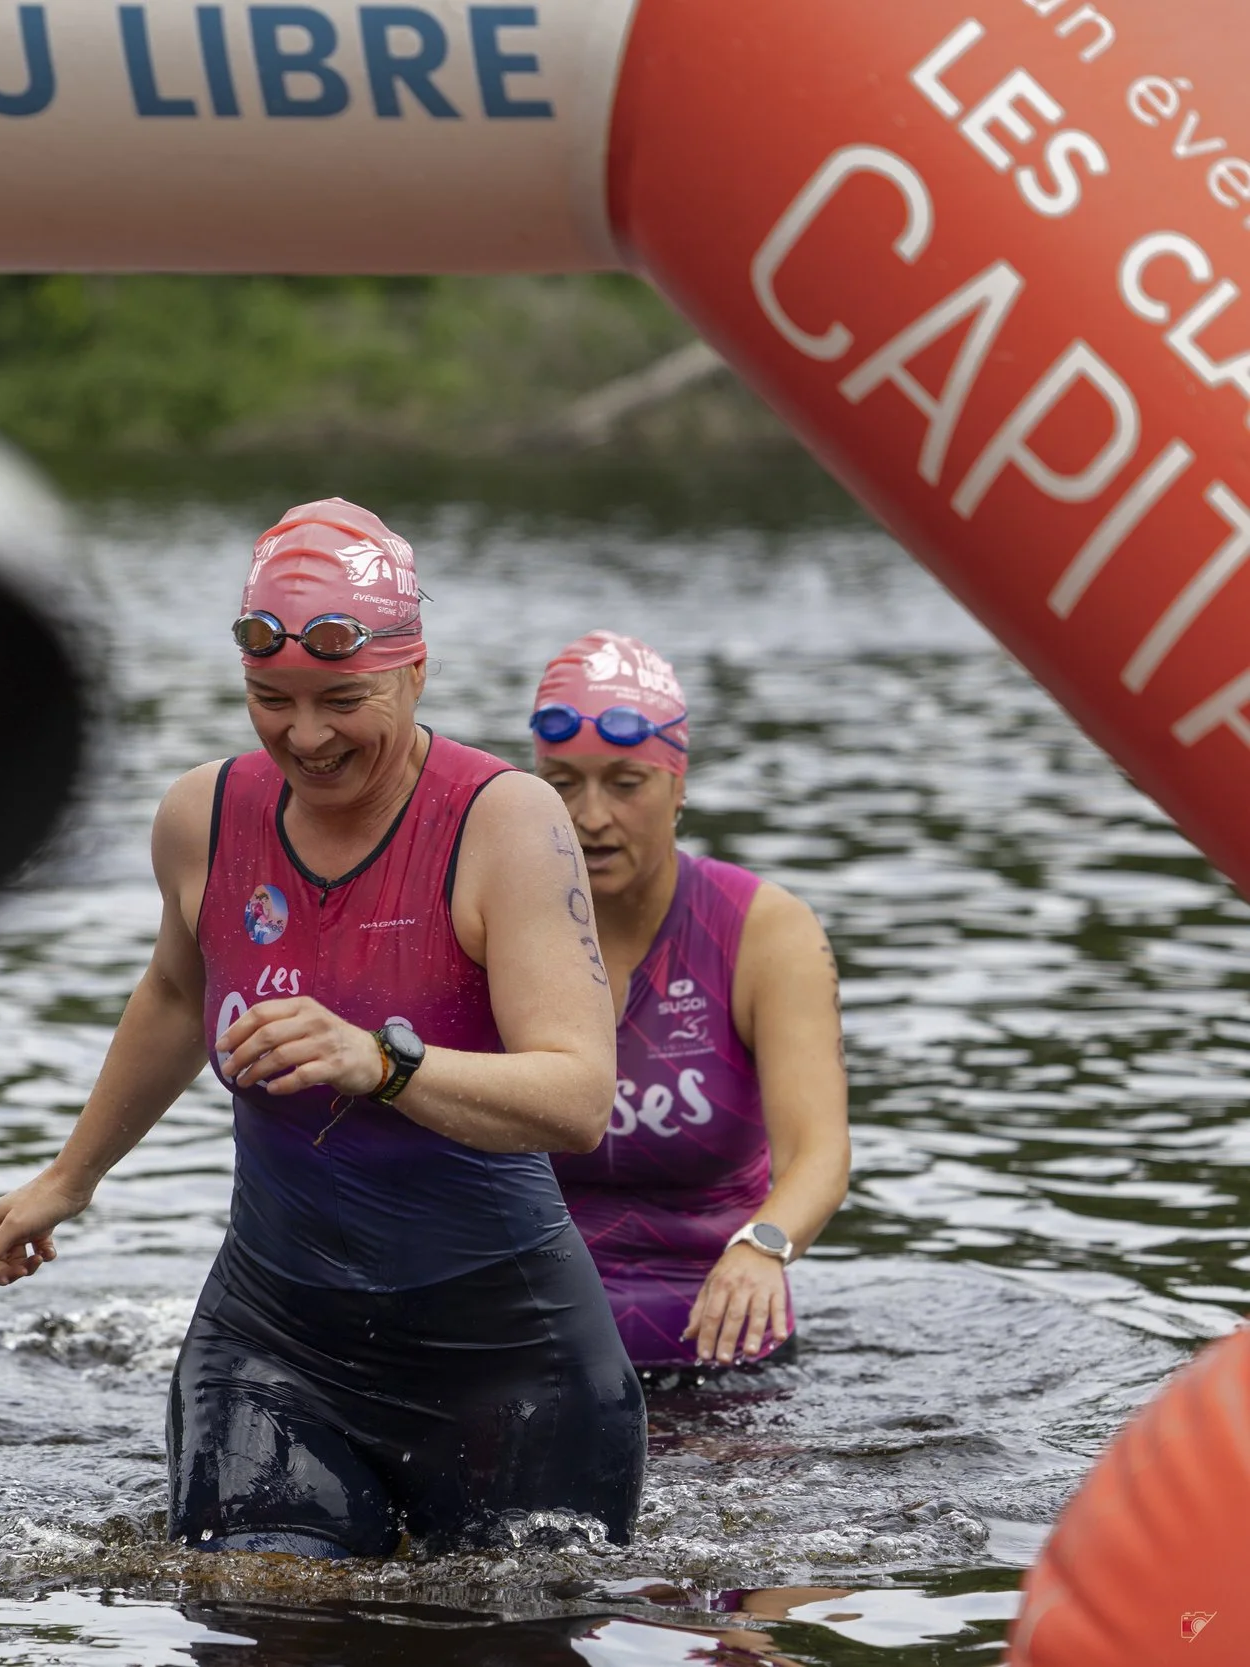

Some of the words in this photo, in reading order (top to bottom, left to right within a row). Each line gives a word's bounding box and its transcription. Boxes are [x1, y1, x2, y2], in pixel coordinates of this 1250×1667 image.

[118, 4, 556, 119] LIBRE
[910, 17, 1109, 218] LES
[358, 918, 417, 930] MAGNAN
[255, 964, 301, 996] Les
